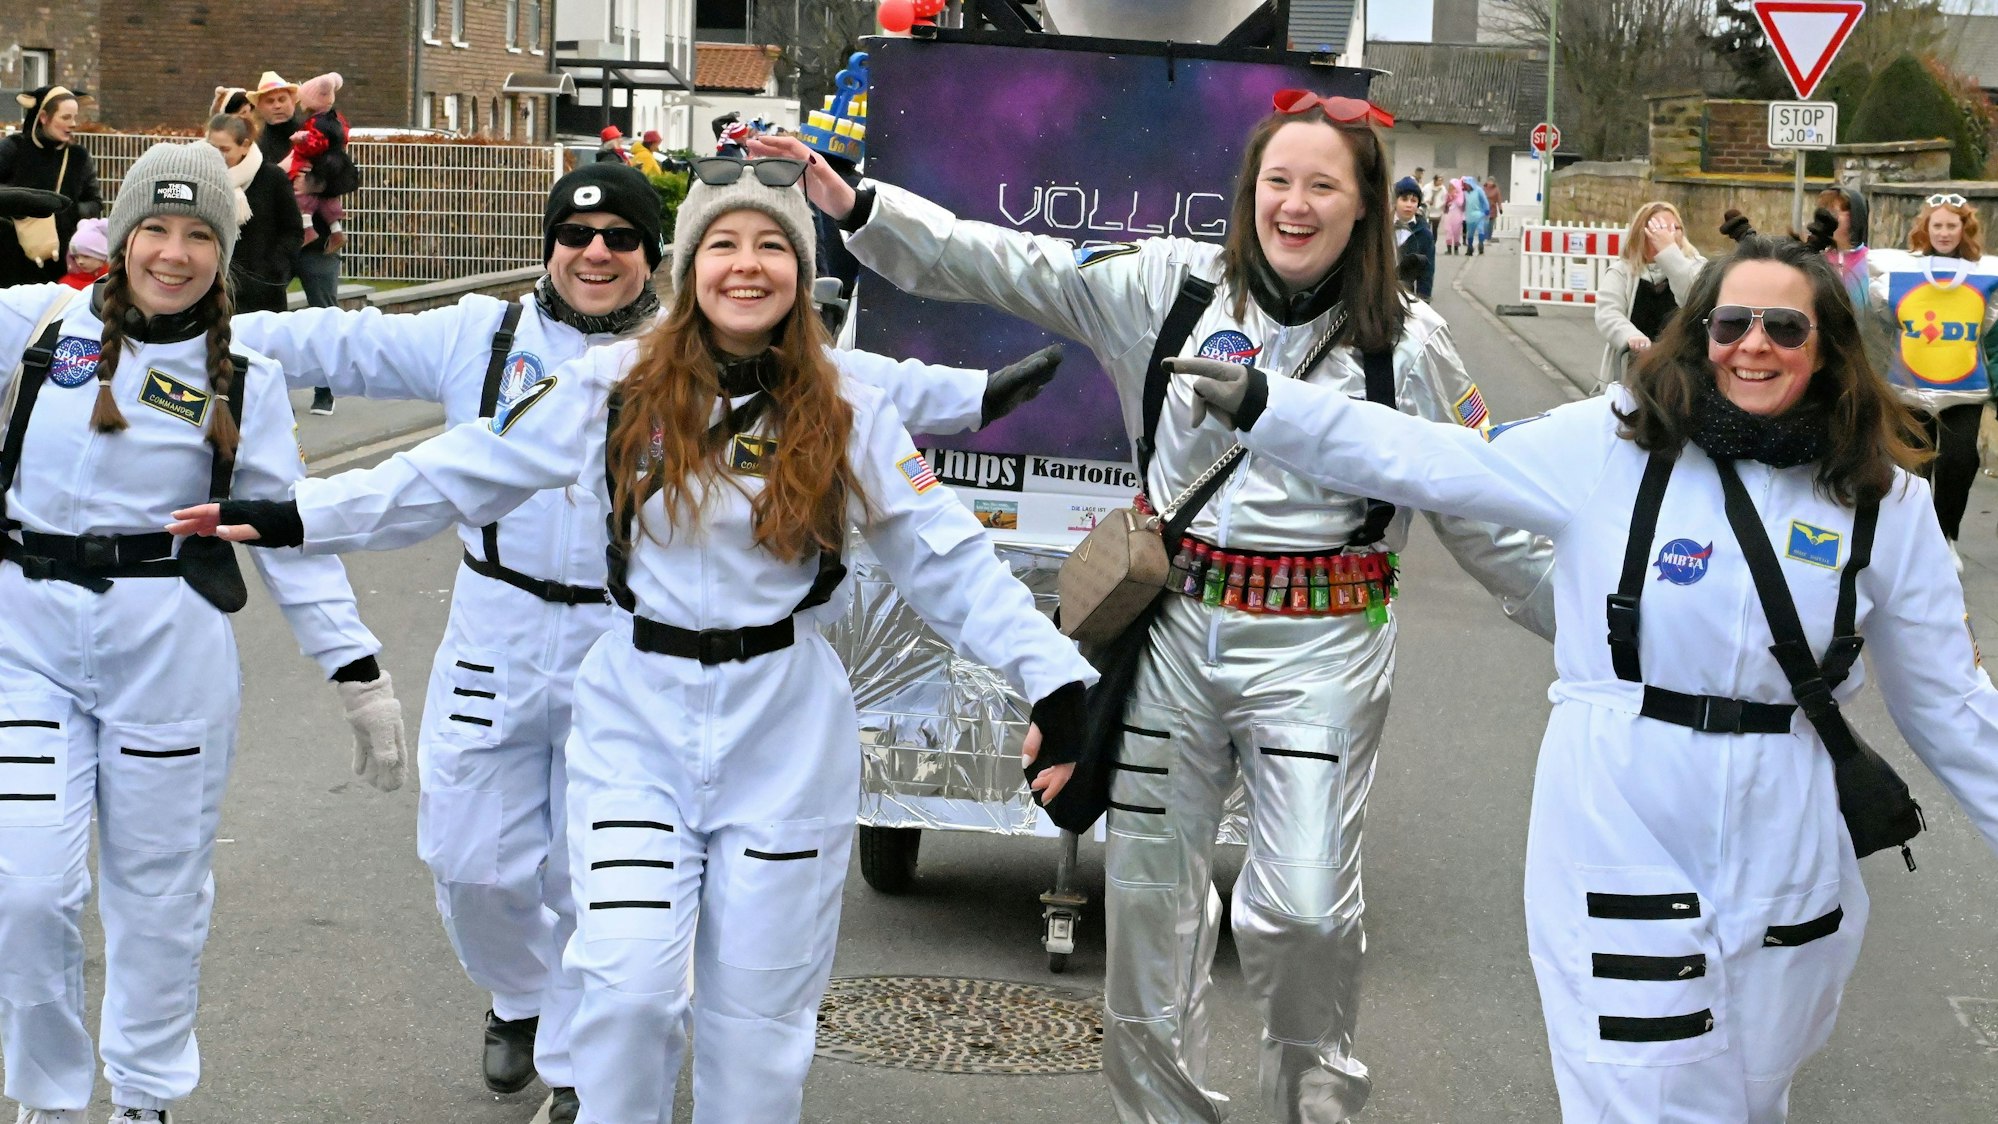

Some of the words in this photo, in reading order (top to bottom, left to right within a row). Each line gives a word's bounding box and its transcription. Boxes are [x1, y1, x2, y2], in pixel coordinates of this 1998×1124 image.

[1780, 108, 1824, 126] STOP
[1534, 132, 1557, 144] STP
[999, 180, 1227, 237] VÖLLIG
[53, 347, 99, 373] SPACE
[150, 394, 195, 419] COMMANDER
[1032, 457, 1141, 488] Kartoffe
[1662, 552, 1704, 570] MIRTA
